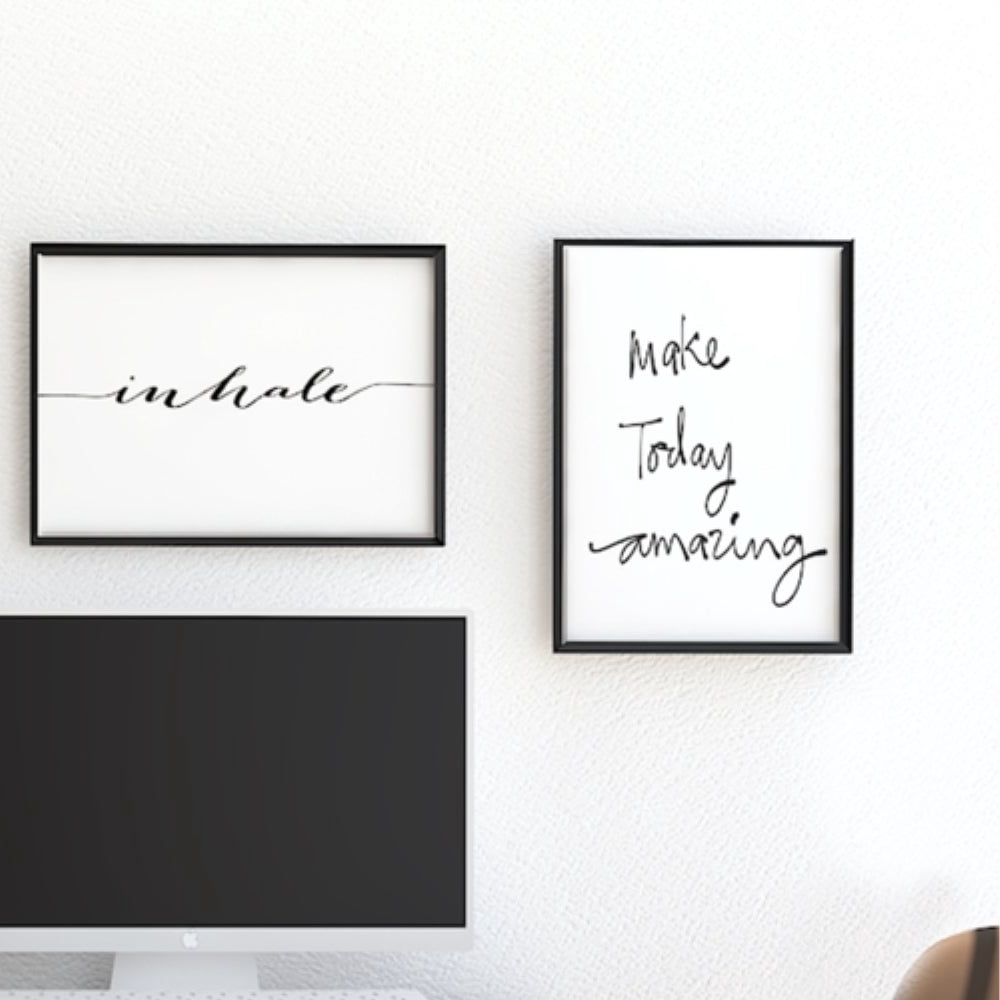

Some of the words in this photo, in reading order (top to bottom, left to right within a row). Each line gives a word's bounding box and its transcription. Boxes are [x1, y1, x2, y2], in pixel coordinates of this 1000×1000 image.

[113, 364, 372, 410] inhale
[618, 405, 737, 518] Today
[588, 511, 828, 608] amazing
